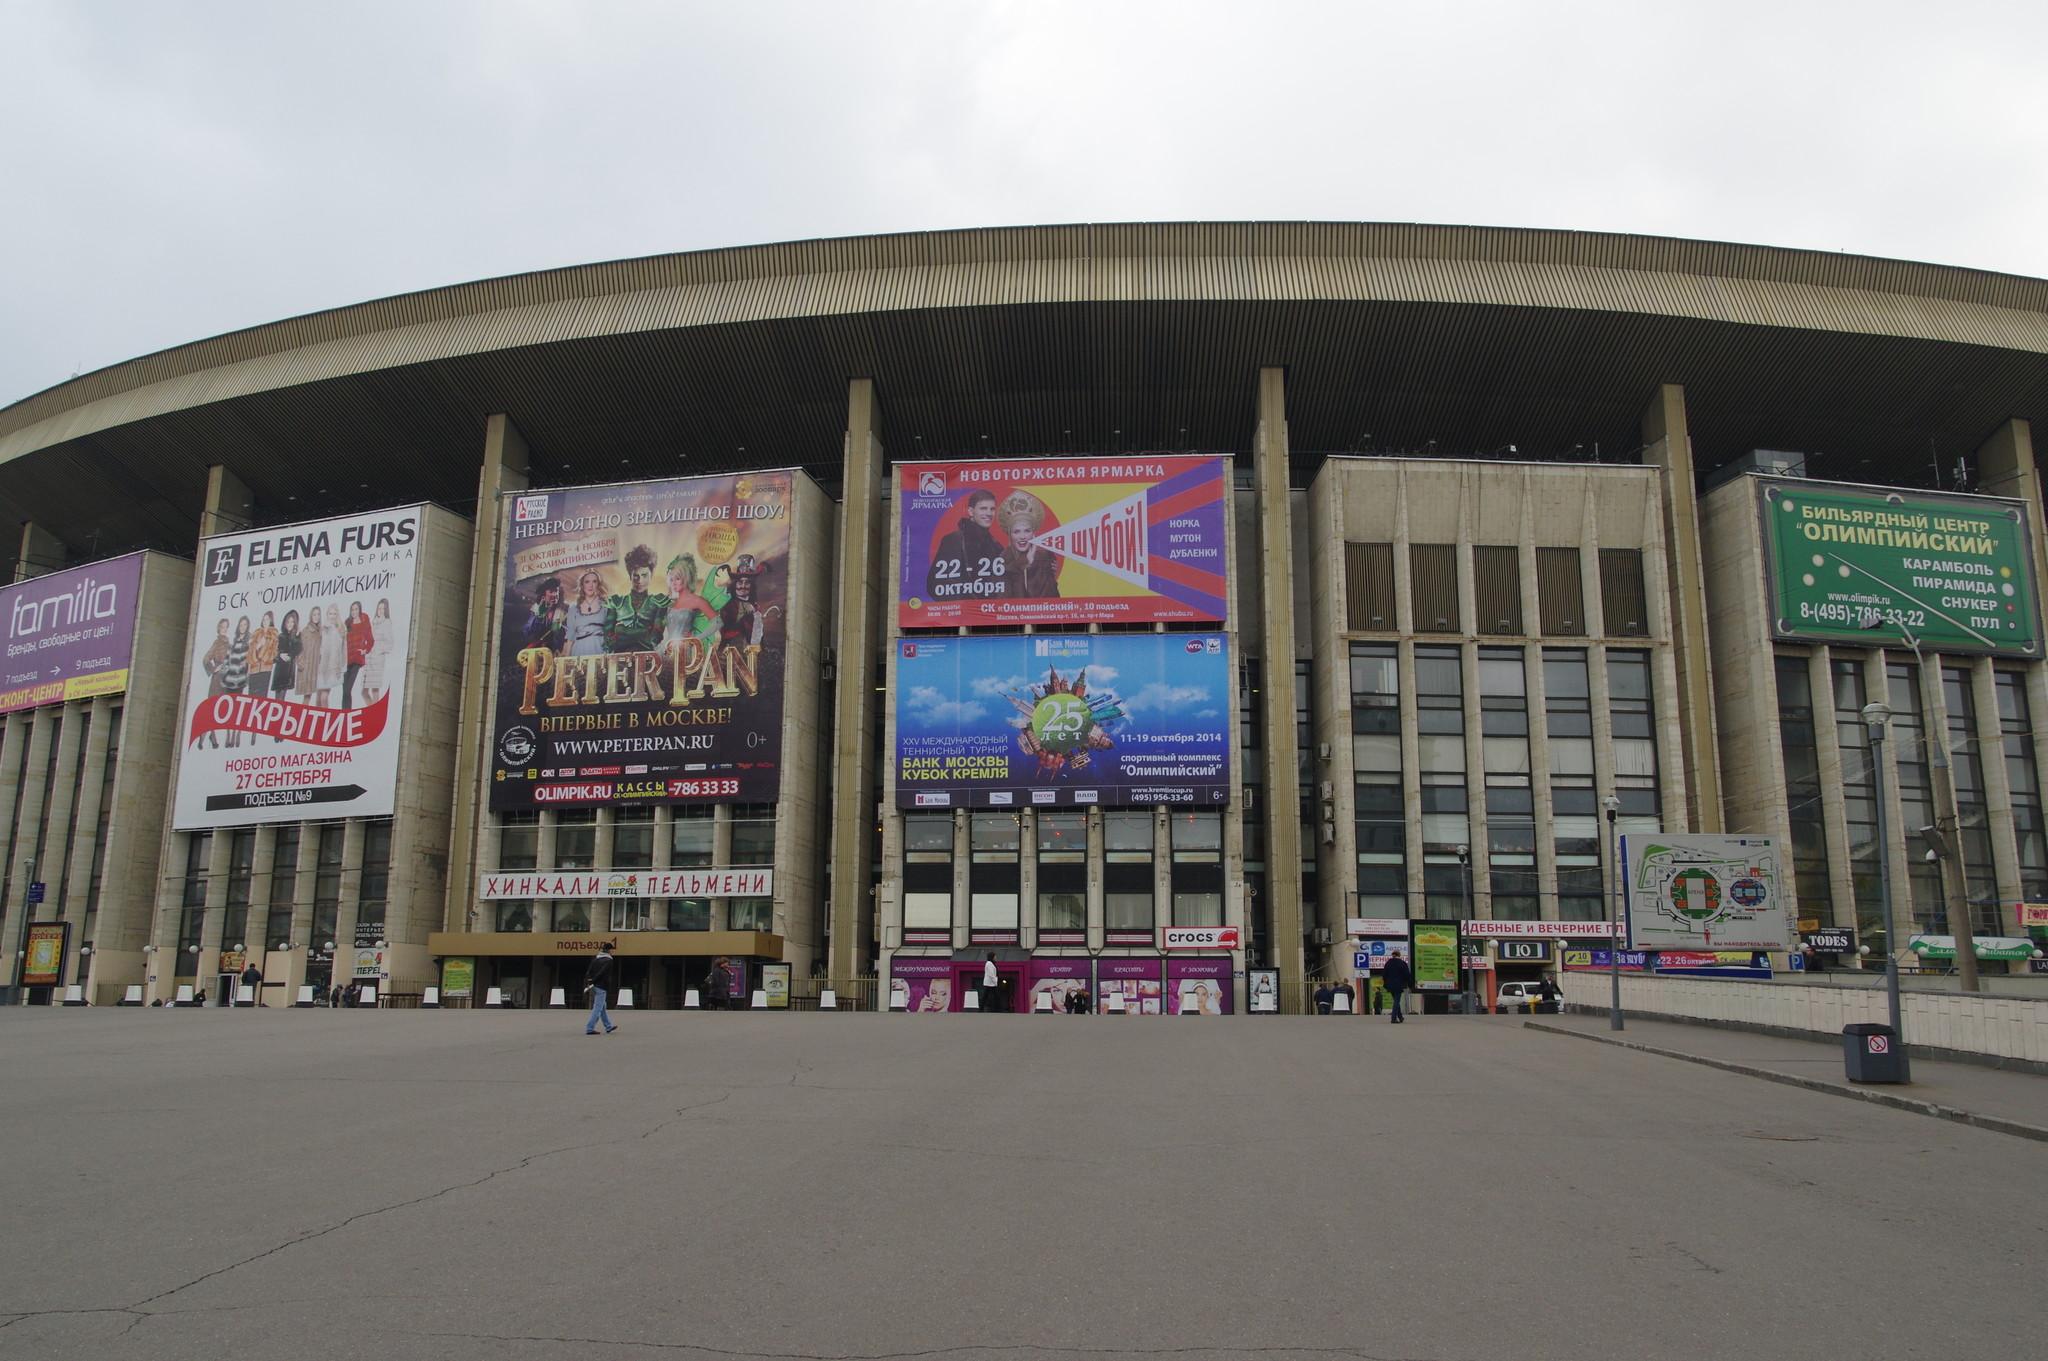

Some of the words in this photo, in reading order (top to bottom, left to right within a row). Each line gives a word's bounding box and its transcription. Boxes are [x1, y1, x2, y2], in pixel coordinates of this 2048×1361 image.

[960, 466, 1086, 482] НОВОТОРЖСКАЯ
[1090, 464, 1165, 478] ЯРМАРКА
[515, 513, 621, 539] НЕВЕРОЯТНО
[624, 505, 730, 525] ЗРЕЛИЩНОЕ
[736, 504, 785, 520] ШОУ!
[1169, 519, 1200, 528] НОРКА
[1802, 504, 1928, 529] БИЛЬЯРДНЫЙ
[1934, 517, 1990, 534] ЦЕНТР
[248, 531, 330, 567] ELENA
[340, 518, 415, 553] FURS
[1071, 501, 1145, 576] шубой!
[1170, 534, 1201, 543] МУТОН
[528, 547, 566, 561] ОКТЯБРЯ
[582, 538, 616, 551] НОЯБРЯ
[1169, 548, 1218, 559] ДУБЛЕНКИ
[246, 560, 321, 581] МЕХОВАЯ
[333, 549, 414, 569] ФАБРИКА
[935, 559, 960, 579] 22
[977, 557, 1005, 577] 26
[1903, 557, 1994, 576] КАРАМБОЛЬ
[934, 578, 1005, 596] октября
[1913, 576, 1997, 595] ПИРАМИДА
[231, 592, 249, 609] СК
[980, 603, 995, 612] СК
[1084, 602, 1094, 610] 10
[1096, 603, 1130, 612] подъезд
[1827, 591, 1890, 606] www.olimpik.ru
[1941, 596, 1998, 611] СНУКЕР
[9, 577, 117, 639] familia
[1800, 601, 1925, 627] 8-(495)-786-33-22
[1970, 616, 2000, 630] ПУЛ
[38, 630, 81, 650] свободные
[75, 660, 82, 670] 9
[82, 656, 111, 670] подъезд
[516, 646, 665, 716] PETER
[666, 637, 762, 707] PAN
[213, 694, 363, 742] ОТКРЫТИЕ
[540, 713, 622, 733] ВПЕРВЫЕ
[629, 712, 639, 728] В
[646, 707, 732, 727] МОСКВЕ!
[1043, 700, 1084, 732] 25
[553, 735, 714, 756] WWW.PETERPAN.RU
[747, 731, 767, 749] 0+
[922, 735, 1008, 746] МЕЖДУНАРОДНЫЙ
[1120, 734, 1149, 742] 11-19
[1150, 733, 1194, 744] октября
[1196, 733, 1222, 742] 2014
[903, 745, 966, 755] ТЕННИСНЫЙ
[970, 746, 1008, 755] ТУРНИР
[1120, 753, 1176, 765] спортивный
[1178, 754, 1222, 764] комплекс
[225, 756, 277, 773] НОВОГО
[280, 750, 352, 768] МАГАЗИНА
[902, 757, 940, 769] БАНК
[945, 756, 1008, 767] МОСКВЫ
[236, 774, 251, 790] 27
[255, 769, 332, 788] СЕНТЯБРЯ
[902, 768, 949, 780] КУБОК
[953, 767, 1008, 779] КРЕМЛЯ
[535, 785, 612, 801] OLIMPIK.RU
[701, 781, 719, 795] 33
[720, 780, 739, 794] 33
[244, 792, 293, 808] ПОДЪЕЗД
[487, 876, 599, 897] ХИНКАЛИ
[647, 874, 764, 895] ПЕЛЬМЕНИ
[607, 887, 637, 896] ПЕРЕЦ
[1462, 923, 1522, 934] АДЕБНЫЕ
[1538, 924, 1602, 934] ВЕЧЕРНИЕ
[1168, 933, 1213, 943] crocs
[1808, 935, 1848, 947] TODES
